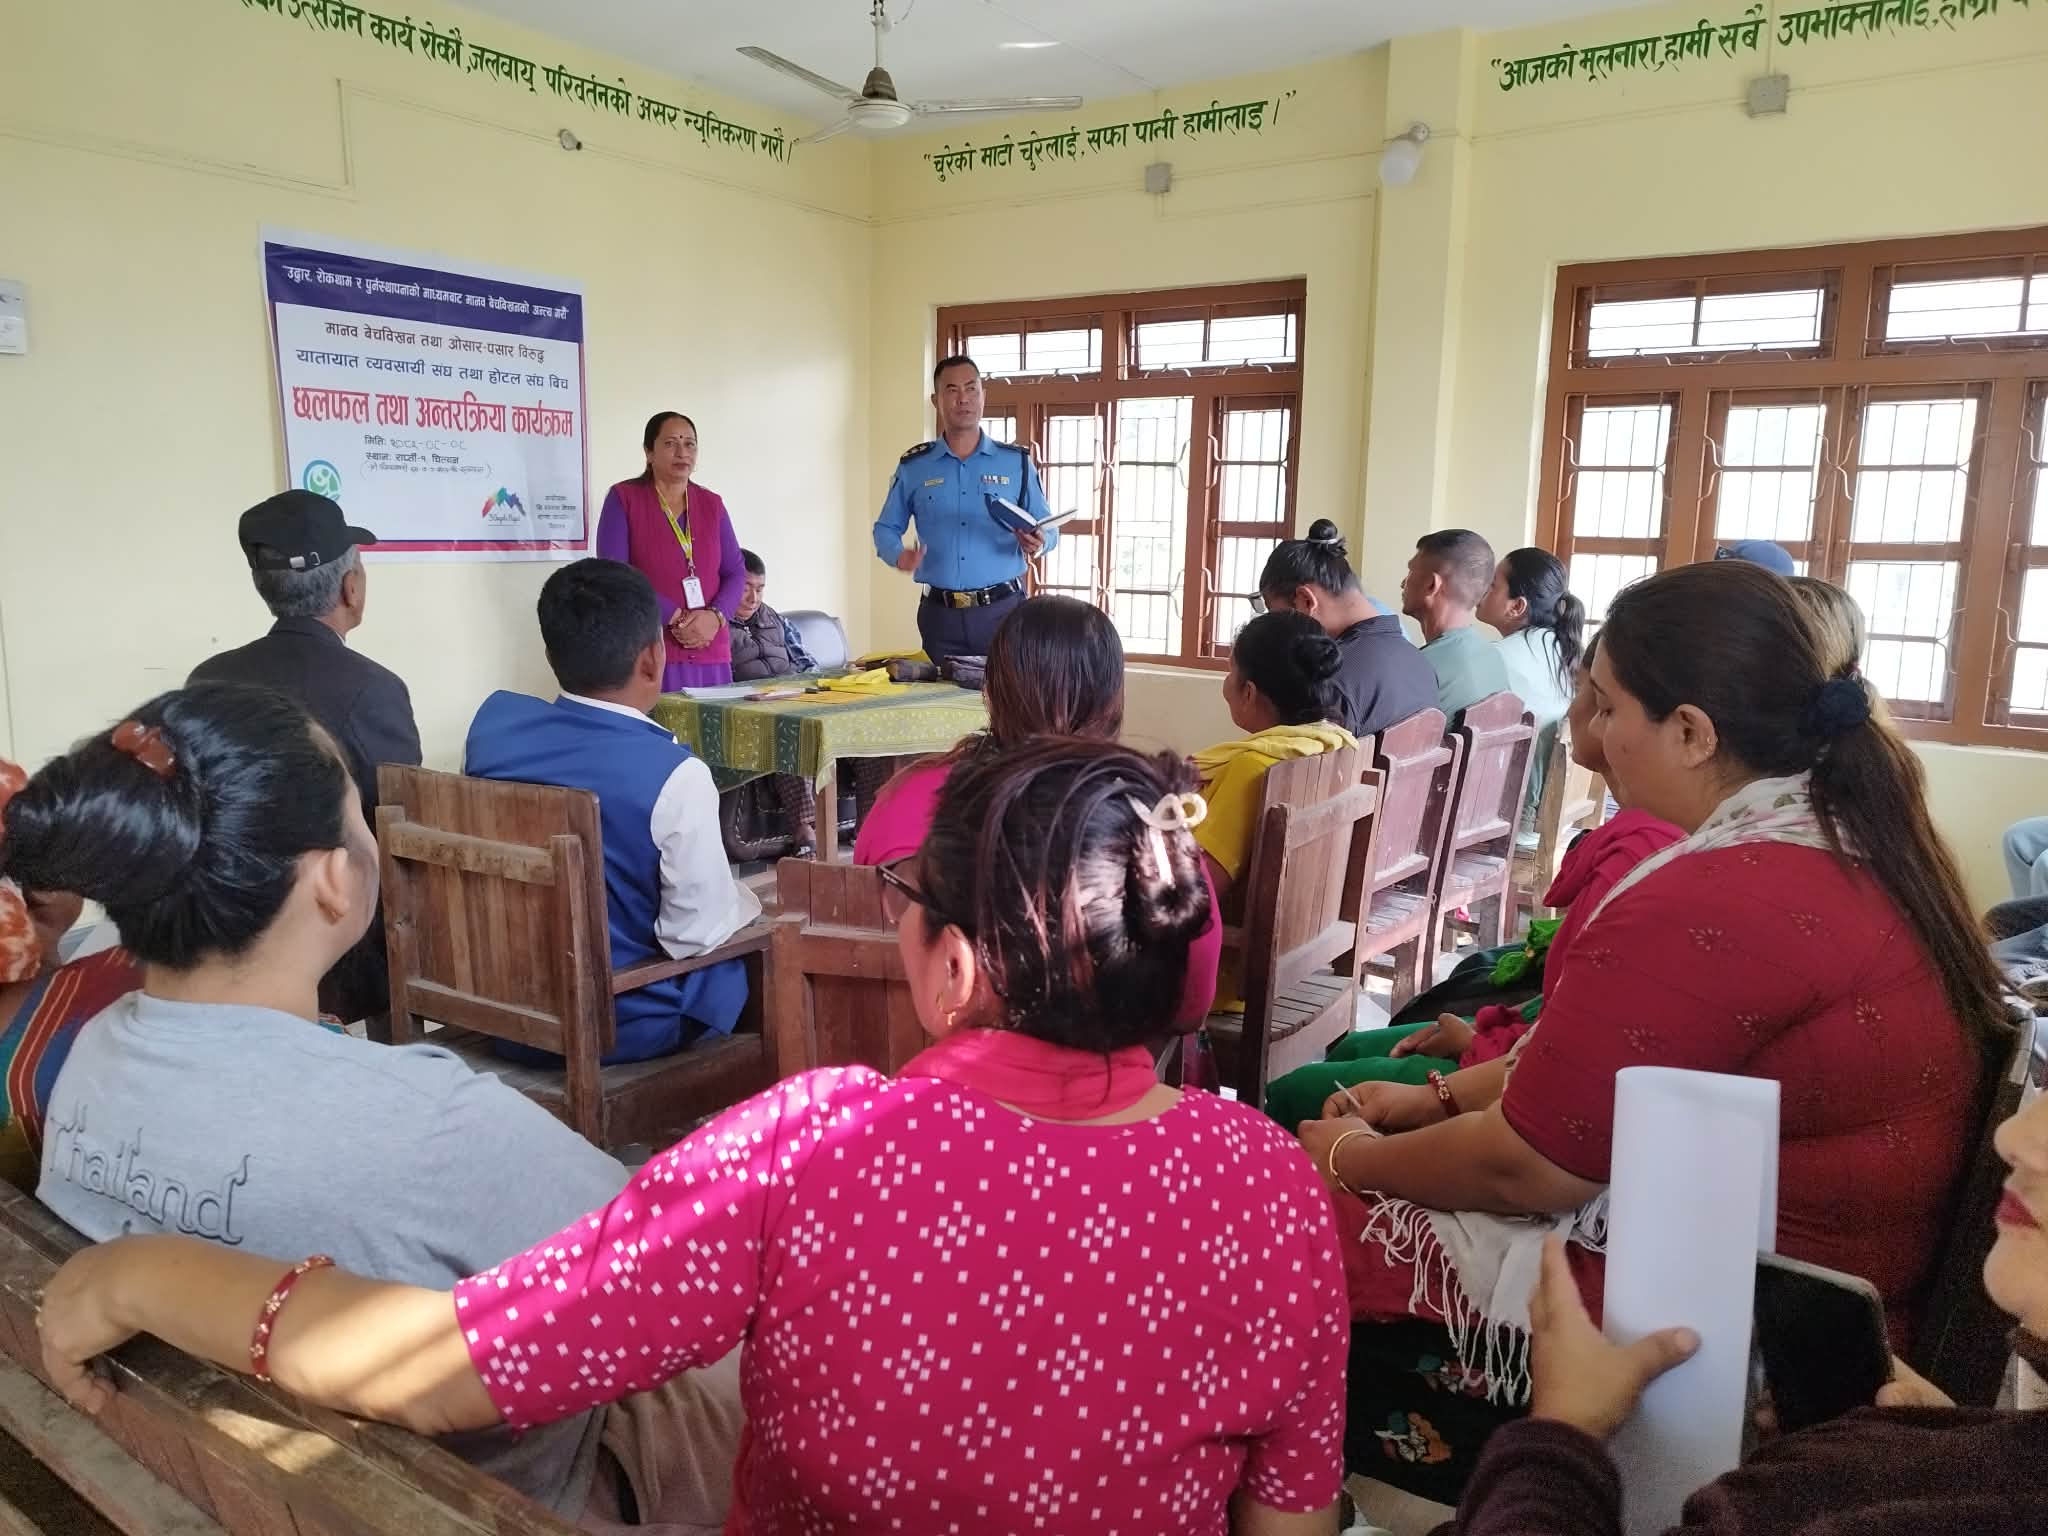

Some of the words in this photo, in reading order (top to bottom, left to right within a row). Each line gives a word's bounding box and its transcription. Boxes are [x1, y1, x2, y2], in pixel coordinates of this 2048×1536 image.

[1664, 19, 1716, 72] हामी
[368, 15, 417, 55] कार्य
[541, 64, 632, 117] परिवर्तनको
[637, 95, 681, 131] असर
[980, 133, 1014, 168] माटो
[1087, 123, 1130, 153] सफा
[1132, 108, 1179, 144] पानी
[354, 277, 362, 289] र
[325, 322, 358, 338] मानव
[420, 334, 442, 348] तथा
[296, 349, 359, 368] यातायात
[432, 362, 453, 377] संघ
[459, 367, 483, 381] तथा
[488, 368, 522, 384] होटल
[292, 386, 370, 425] छलफल
[375, 393, 409, 426] तथा
[415, 390, 506, 433] अन्तरक्रिया
[512, 400, 574, 437] कार्यक्रम
